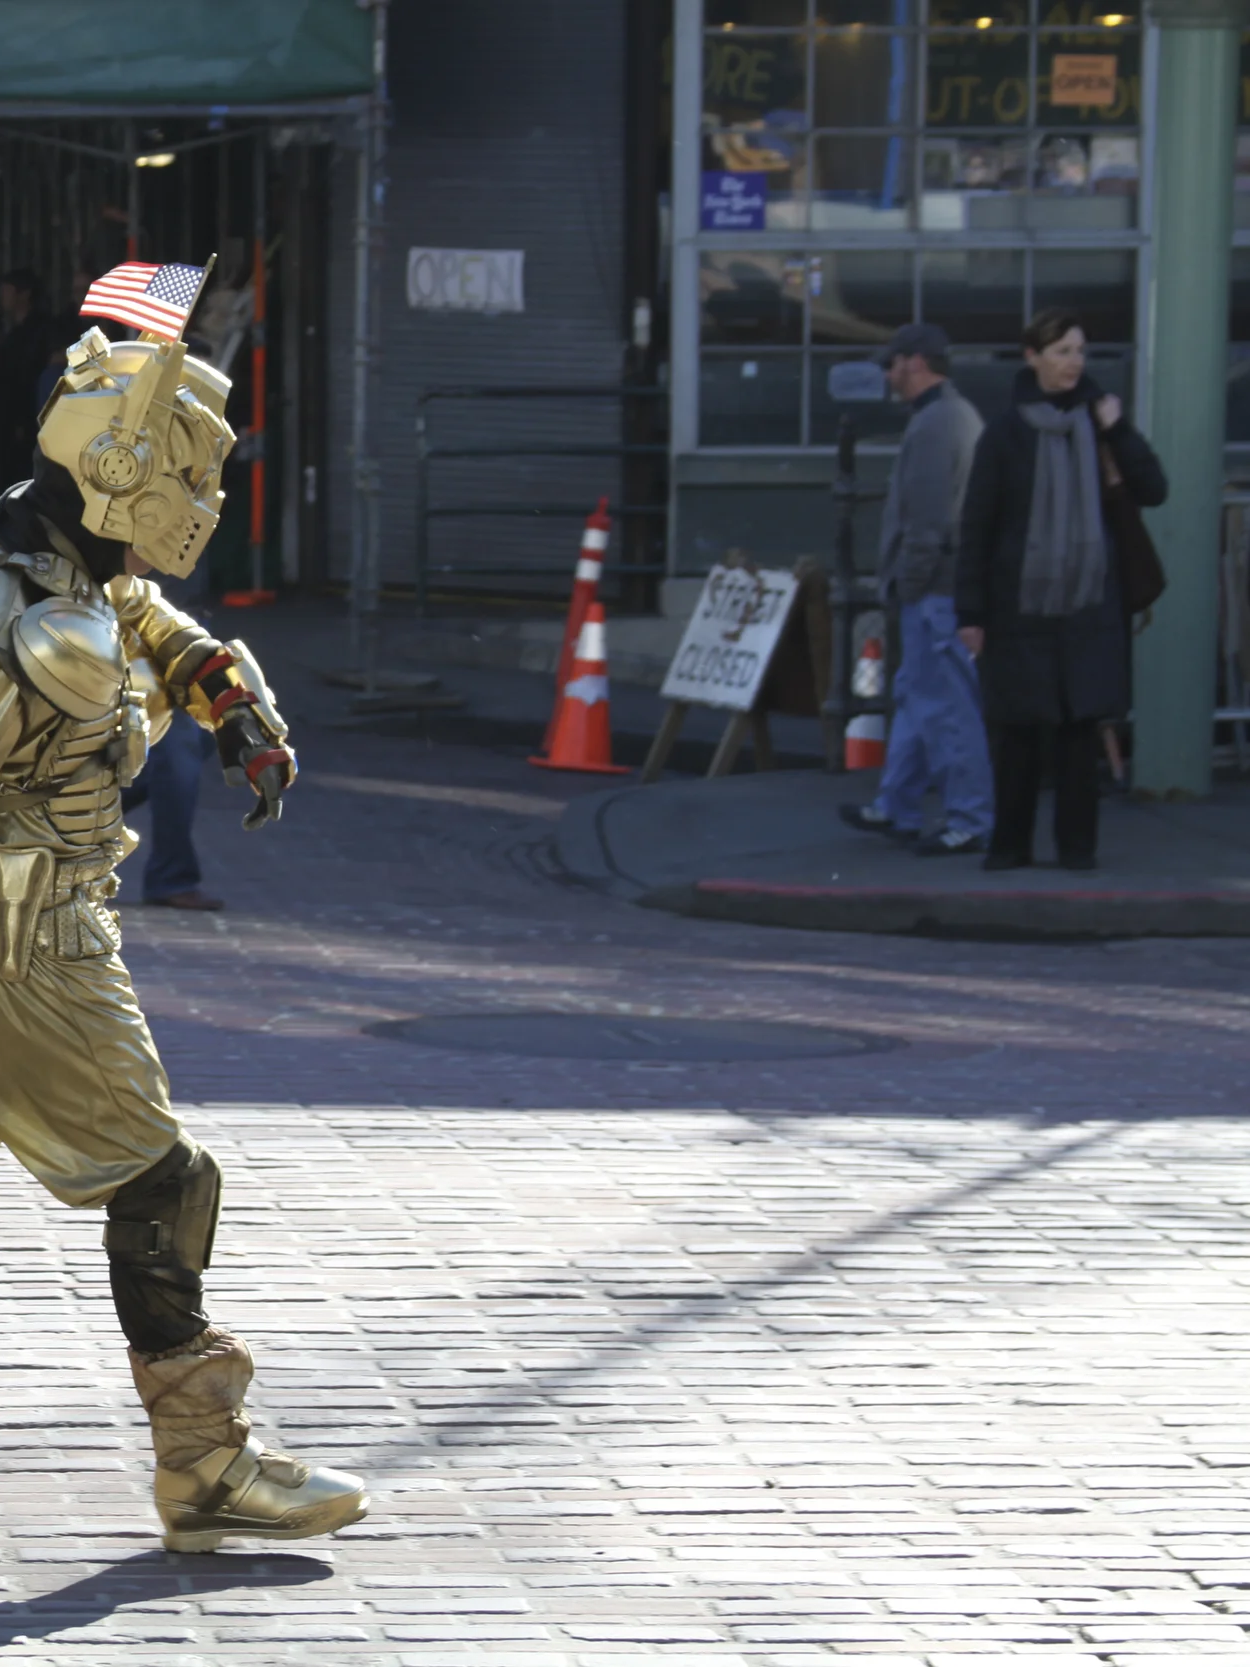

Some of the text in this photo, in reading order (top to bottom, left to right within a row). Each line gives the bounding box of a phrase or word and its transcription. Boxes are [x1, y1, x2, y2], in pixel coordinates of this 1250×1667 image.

[1052, 73, 1112, 92] OPEN
[413, 252, 518, 303] OPEN
[676, 643, 760, 689] CLOSED
